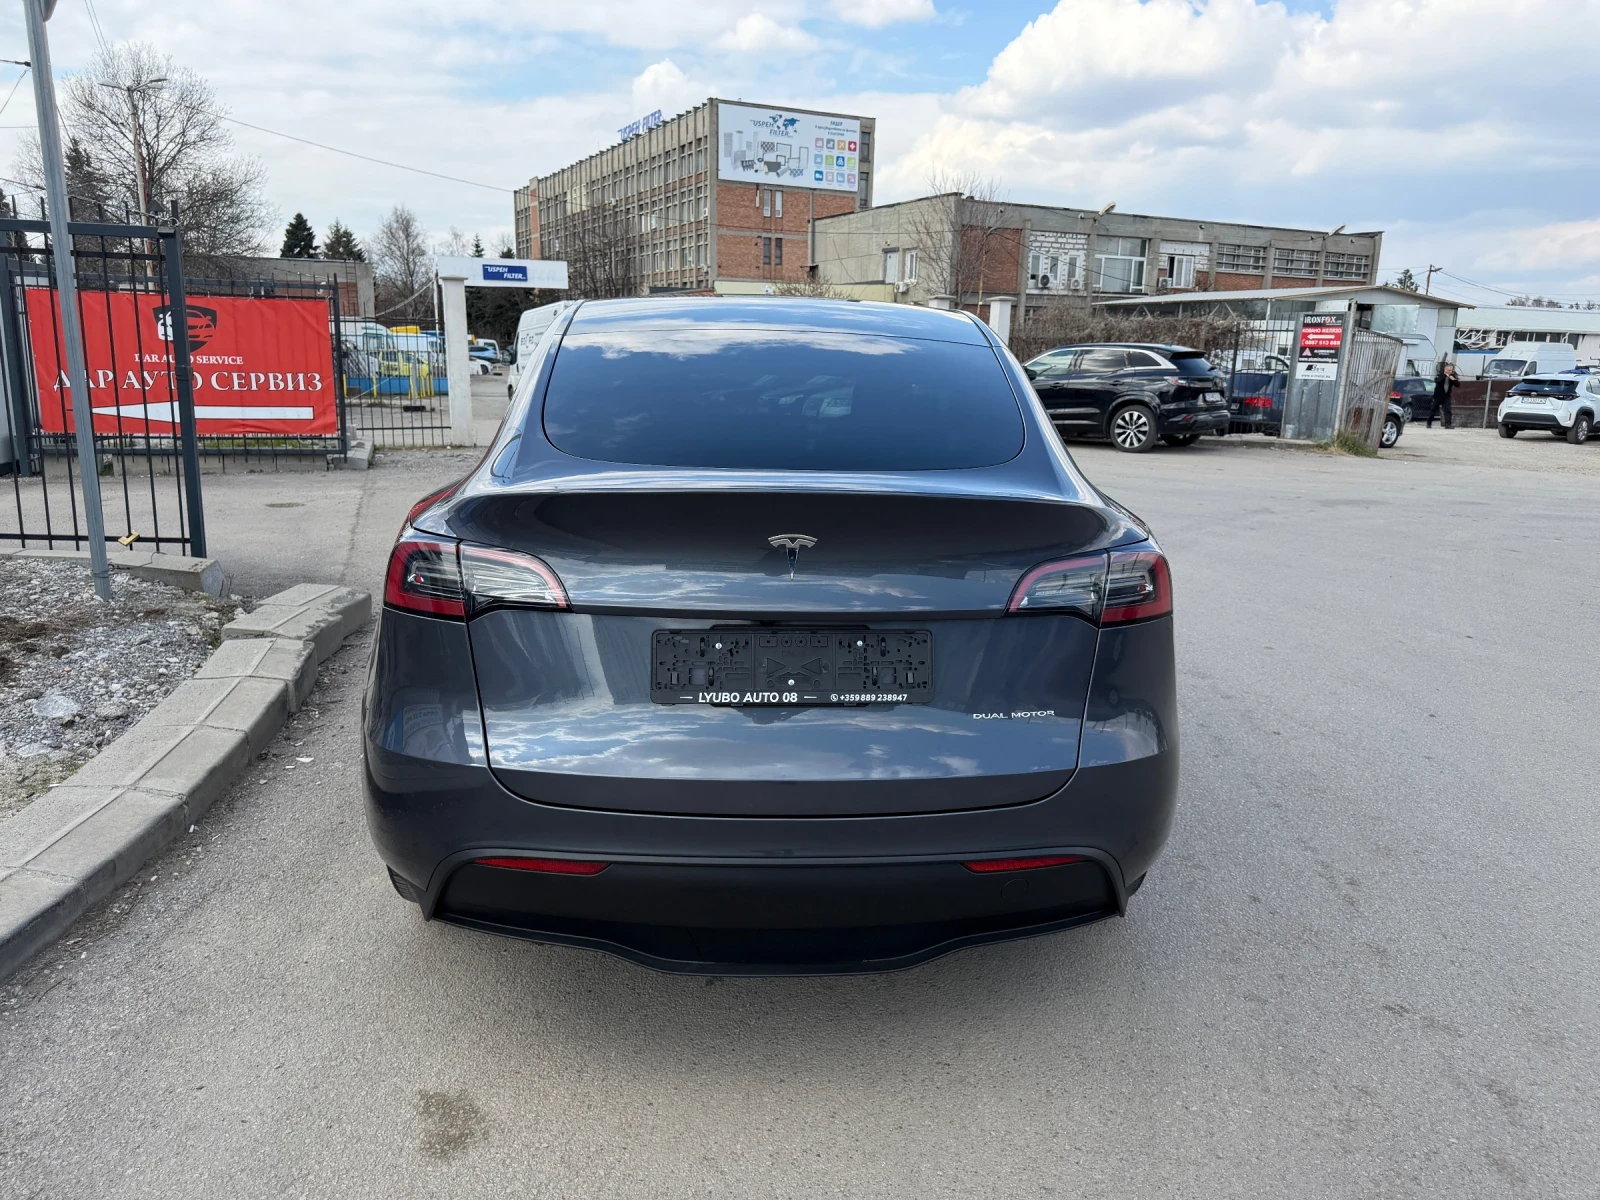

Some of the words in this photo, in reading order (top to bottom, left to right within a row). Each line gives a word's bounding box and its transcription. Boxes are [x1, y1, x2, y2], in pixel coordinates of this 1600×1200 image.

[751, 119, 774, 128] USPEH
[770, 129, 790, 137] FILTER
[486, 265, 508, 273] USPEH
[196, 355, 244, 365] SERVICE
[210, 371, 323, 392] СЕРВИЗ
[698, 692, 740, 703] LYUBO
[743, 692, 780, 703] AUTO
[782, 692, 798, 703] 08
[877, 693, 908, 702] 238947
[1011, 710, 1055, 719] MOTOR
